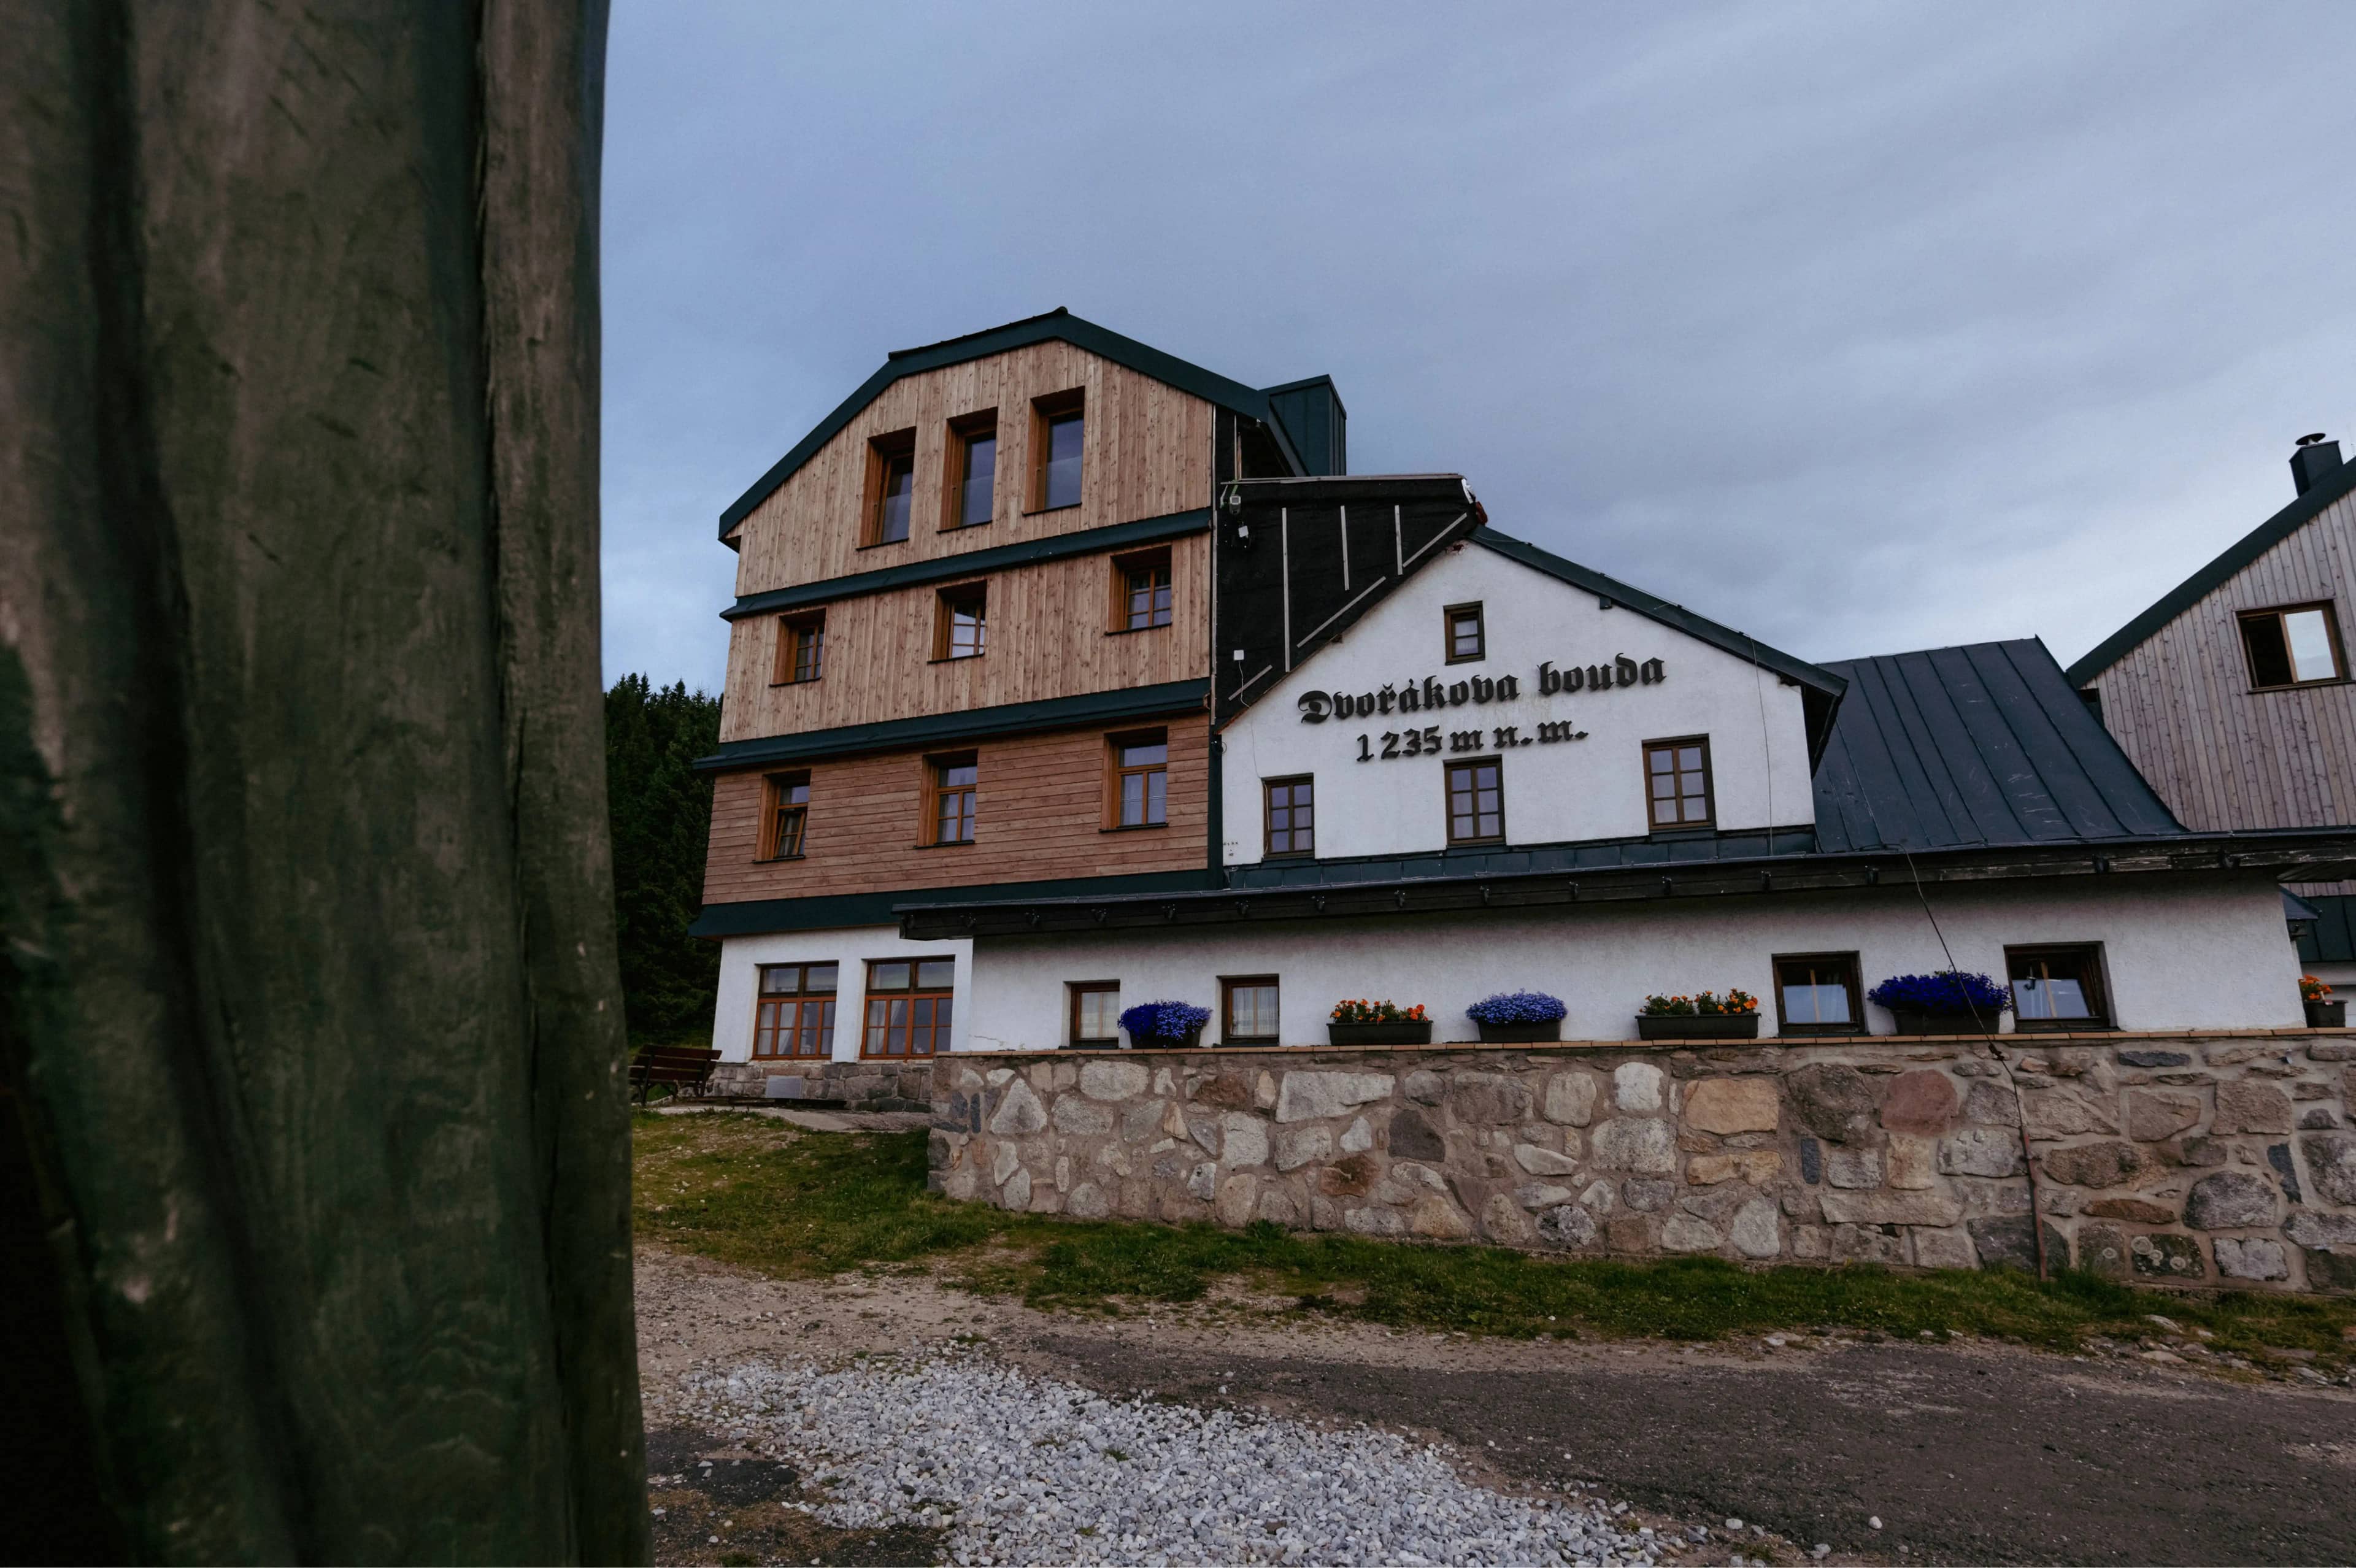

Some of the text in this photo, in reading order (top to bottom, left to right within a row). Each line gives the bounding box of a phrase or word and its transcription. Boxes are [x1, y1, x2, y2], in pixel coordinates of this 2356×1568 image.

[1297, 652, 1667, 724] Dvořákova bouda
[1356, 724, 1443, 763] 1235
